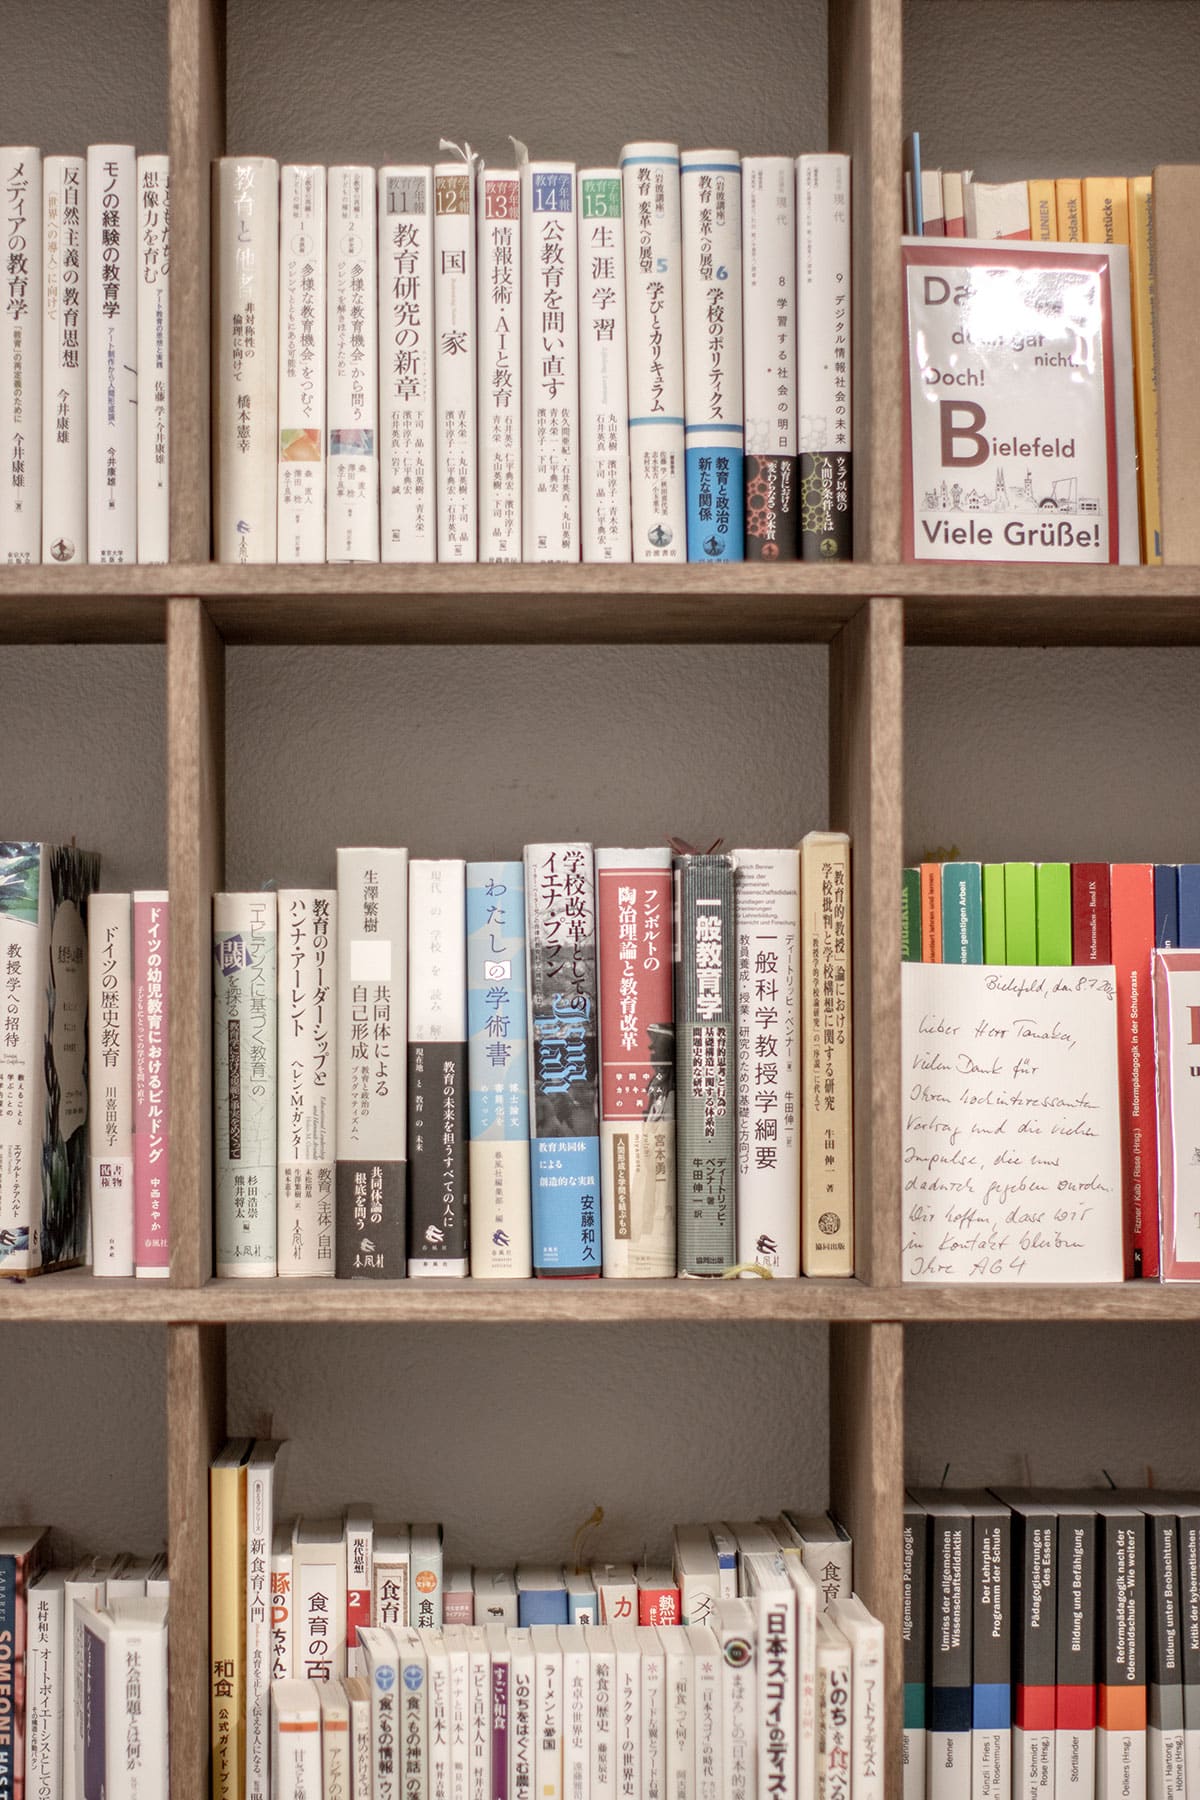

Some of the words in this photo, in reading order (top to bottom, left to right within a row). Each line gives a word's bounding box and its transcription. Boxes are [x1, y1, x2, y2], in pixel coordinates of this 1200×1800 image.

[389, 192, 407, 213] 11
[437, 191, 457, 214] 12
[486, 196, 507, 218] 13
[536, 189, 558, 211] 14
[585, 194, 607, 216] 15
[6, 163, 29, 320] メディアの教育学
[102, 162, 120, 319] モノの経験の教育学
[143, 171, 159, 284] 想像力を育む
[63, 167, 79, 368] 反自然主義の教育思想
[591, 226, 616, 341] 生涯学習
[656, 258, 669, 273] 5
[716, 266, 729, 281] 6
[779, 276, 786, 287] 8
[836, 273, 844, 284] 9
[244, 302, 256, 358] 非対称性の
[393, 223, 420, 402] 教育研究の新章
[492, 227, 513, 408] 情報技術・AIと教育
[541, 219, 565, 400] 公教育を問い直す
[233, 314, 244, 382] 倫理に向けて
[646, 281, 665, 412] 学びとカリキュラム
[707, 288, 724, 420] 学校のポリティクス
[834, 294, 847, 445] デジタル情報社会の未来
[777, 298, 789, 448] 学習する社会の明日
[926, 367, 986, 387] Doch!
[56, 389, 70, 443] 今井康雄
[237, 394, 251, 454] 橋本憲幸
[939, 399, 1076, 468] Bielefeld
[12, 432, 25, 487] 今井康雄
[106, 447, 117, 486] 今井康雄
[698, 457, 713, 522] 新たな関係
[716, 456, 729, 534] 教育と政治の
[821, 458, 835, 532] 人間の条件とは
[921, 520, 993, 544] Viele
[1003, 521, 1101, 548] Grüße!
[363, 869, 379, 933] 生澤繁樹
[959, 881, 967, 906] Arbeit
[1089, 880, 1097, 890] IX
[1089, 891, 1097, 908] Band
[540, 850, 566, 979] イエナ・プラン
[562, 849, 587, 1011] 学校改革としての
[642, 889, 660, 971] フンボルトの
[959, 908, 968, 945] geistigen
[290, 900, 306, 1038] ハンナ・アーレント
[484, 877, 512, 1067] わたしの学術書
[618, 886, 638, 1051] 陶冶理論と教育改革
[696, 899, 722, 1020] 一般教育学
[833, 862, 846, 1045] 「教育的教授」論における
[4, 943, 23, 1048] 教授学への招待
[101, 926, 120, 1068] ドイツの歴史教育
[312, 898, 330, 1087] 教育のリーダーシップと
[821, 863, 835, 1111] 学校批判と学校構想に関する研究
[1129, 971, 1138, 1019] Schulpraxis
[147, 907, 163, 1163] ドイツの幼児教育におけるビルドゥング
[351, 985, 369, 1060] 自己形成
[373, 985, 391, 1097] 共同体による
[974, 1019, 1009, 1038] Herr
[1130, 1020, 1138, 1035] der
[1131, 1036, 1138, 1044] in
[754, 935, 779, 1170] 一般科学教授学綱要
[1012, 1059, 1039, 1079] für
[350, 1066, 360, 1142] プラグマティズムへ
[361, 1066, 370, 1117] 教育と政治の
[1131, 1045, 1140, 1117] Reformpädagogik
[105, 1086, 118, 1147] 川喜田敦子
[290, 1061, 304, 1160] ヘレン・M・ガンター
[784, 1090, 794, 1130] 牛田伸一
[970, 1118, 1005, 1135] und
[1017, 1119, 1043, 1135] die
[442, 1061, 456, 1227] 教育の未来を担うすべての人に
[539, 1141, 587, 1153] 教育共同体
[540, 1160, 563, 1169] による
[824, 1128, 835, 1172] 牛田伸一
[993, 1151, 1024, 1166] die
[1132, 1128, 1142, 1155] (Hrsg.)
[540, 1175, 596, 1188] 創造的な実践
[1133, 1156, 1141, 1177] Risse
[150, 1177, 161, 1231] 中西さやか
[234, 1175, 245, 1218] 熊井将太
[354, 1172, 367, 1231] 根底を問う
[370, 1166, 384, 1224] 共同体論の
[1004, 1208, 1043, 1224] dass
[1133, 1184, 1141, 1201] Kalb
[580, 1194, 596, 1262] 安藤和久
[938, 1232, 1010, 1253] Kontakt
[1133, 1206, 1142, 1234] Fitzner
[353, 1538, 365, 1574] 現代思想
[942, 1530, 952, 1594] allgemeinen
[982, 1537, 992, 1583] Lehrplan
[992, 1527, 1001, 1563] Schule
[1042, 1529, 1051, 1566] Essens
[1073, 1528, 1085, 1589] Befähigung
[1117, 1529, 1126, 1547] der
[1127, 1529, 1136, 1566] weiter?
[250, 1537, 265, 1623] 新食育入門
[992, 1564, 1001, 1582] der
[1031, 1529, 1043, 1628] Pädagogisierungen
[1042, 1567, 1051, 1587] des
[1117, 1554, 1126, 1574] nach
[1127, 1569, 1136, 1588] Wie
[1163, 1529, 1174, 1598] Beobachtung
[1188, 1529, 1200, 1599] kybernetischen
[349, 1592, 361, 1607] 2
[902, 1583, 913, 1641] Allgemeine
[942, 1597, 951, 1613] der
[951, 1530, 963, 1648] Wissenschaftsdidaktik
[981, 1588, 991, 1604] Der
[992, 1584, 1003, 1638] Programm
[1073, 1590, 1082, 1611] und
[1190, 1601, 1199, 1620] der
[37, 1600, 50, 1643] 北村和夫
[941, 1617, 951, 1651] Umriss
[1071, 1611, 1084, 1651] Bildung
[1116, 1576, 1127, 1664] Reformpädagogik
[1165, 1599, 1175, 1628] unter
[1190, 1622, 1200, 1650] Kritik
[1127, 1599, 1136, 1681] Odenwaldschule
[1165, 1629, 1176, 1669] Bildung
[213, 1659, 235, 1698] 和食
[596, 1663, 609, 1733] 給食の歴史
[125, 1651, 142, 1771] 社会問題とは何か
[433, 1670, 446, 1745] エビと日本人
[542, 1664, 556, 1751] ラーメンと愛国
[622, 1672, 634, 1796] トラクターの世界史
[945, 1737, 954, 1769] Benner
[1040, 1736, 1050, 1764] (Hrsg.)
[1123, 1736, 1132, 1763] (Hrsg.)
[1175, 1735, 1185, 1763] (Hrsg.)
[993, 1735, 1001, 1785] Rosenmund
[1030, 1743, 1039, 1778] Schmidt
[1039, 1764, 1048, 1786] Rose
[1071, 1735, 1080, 1783] Störtländer
[1122, 1763, 1131, 1797] Oelkers
[1165, 1744, 1174, 1779] Hartong
